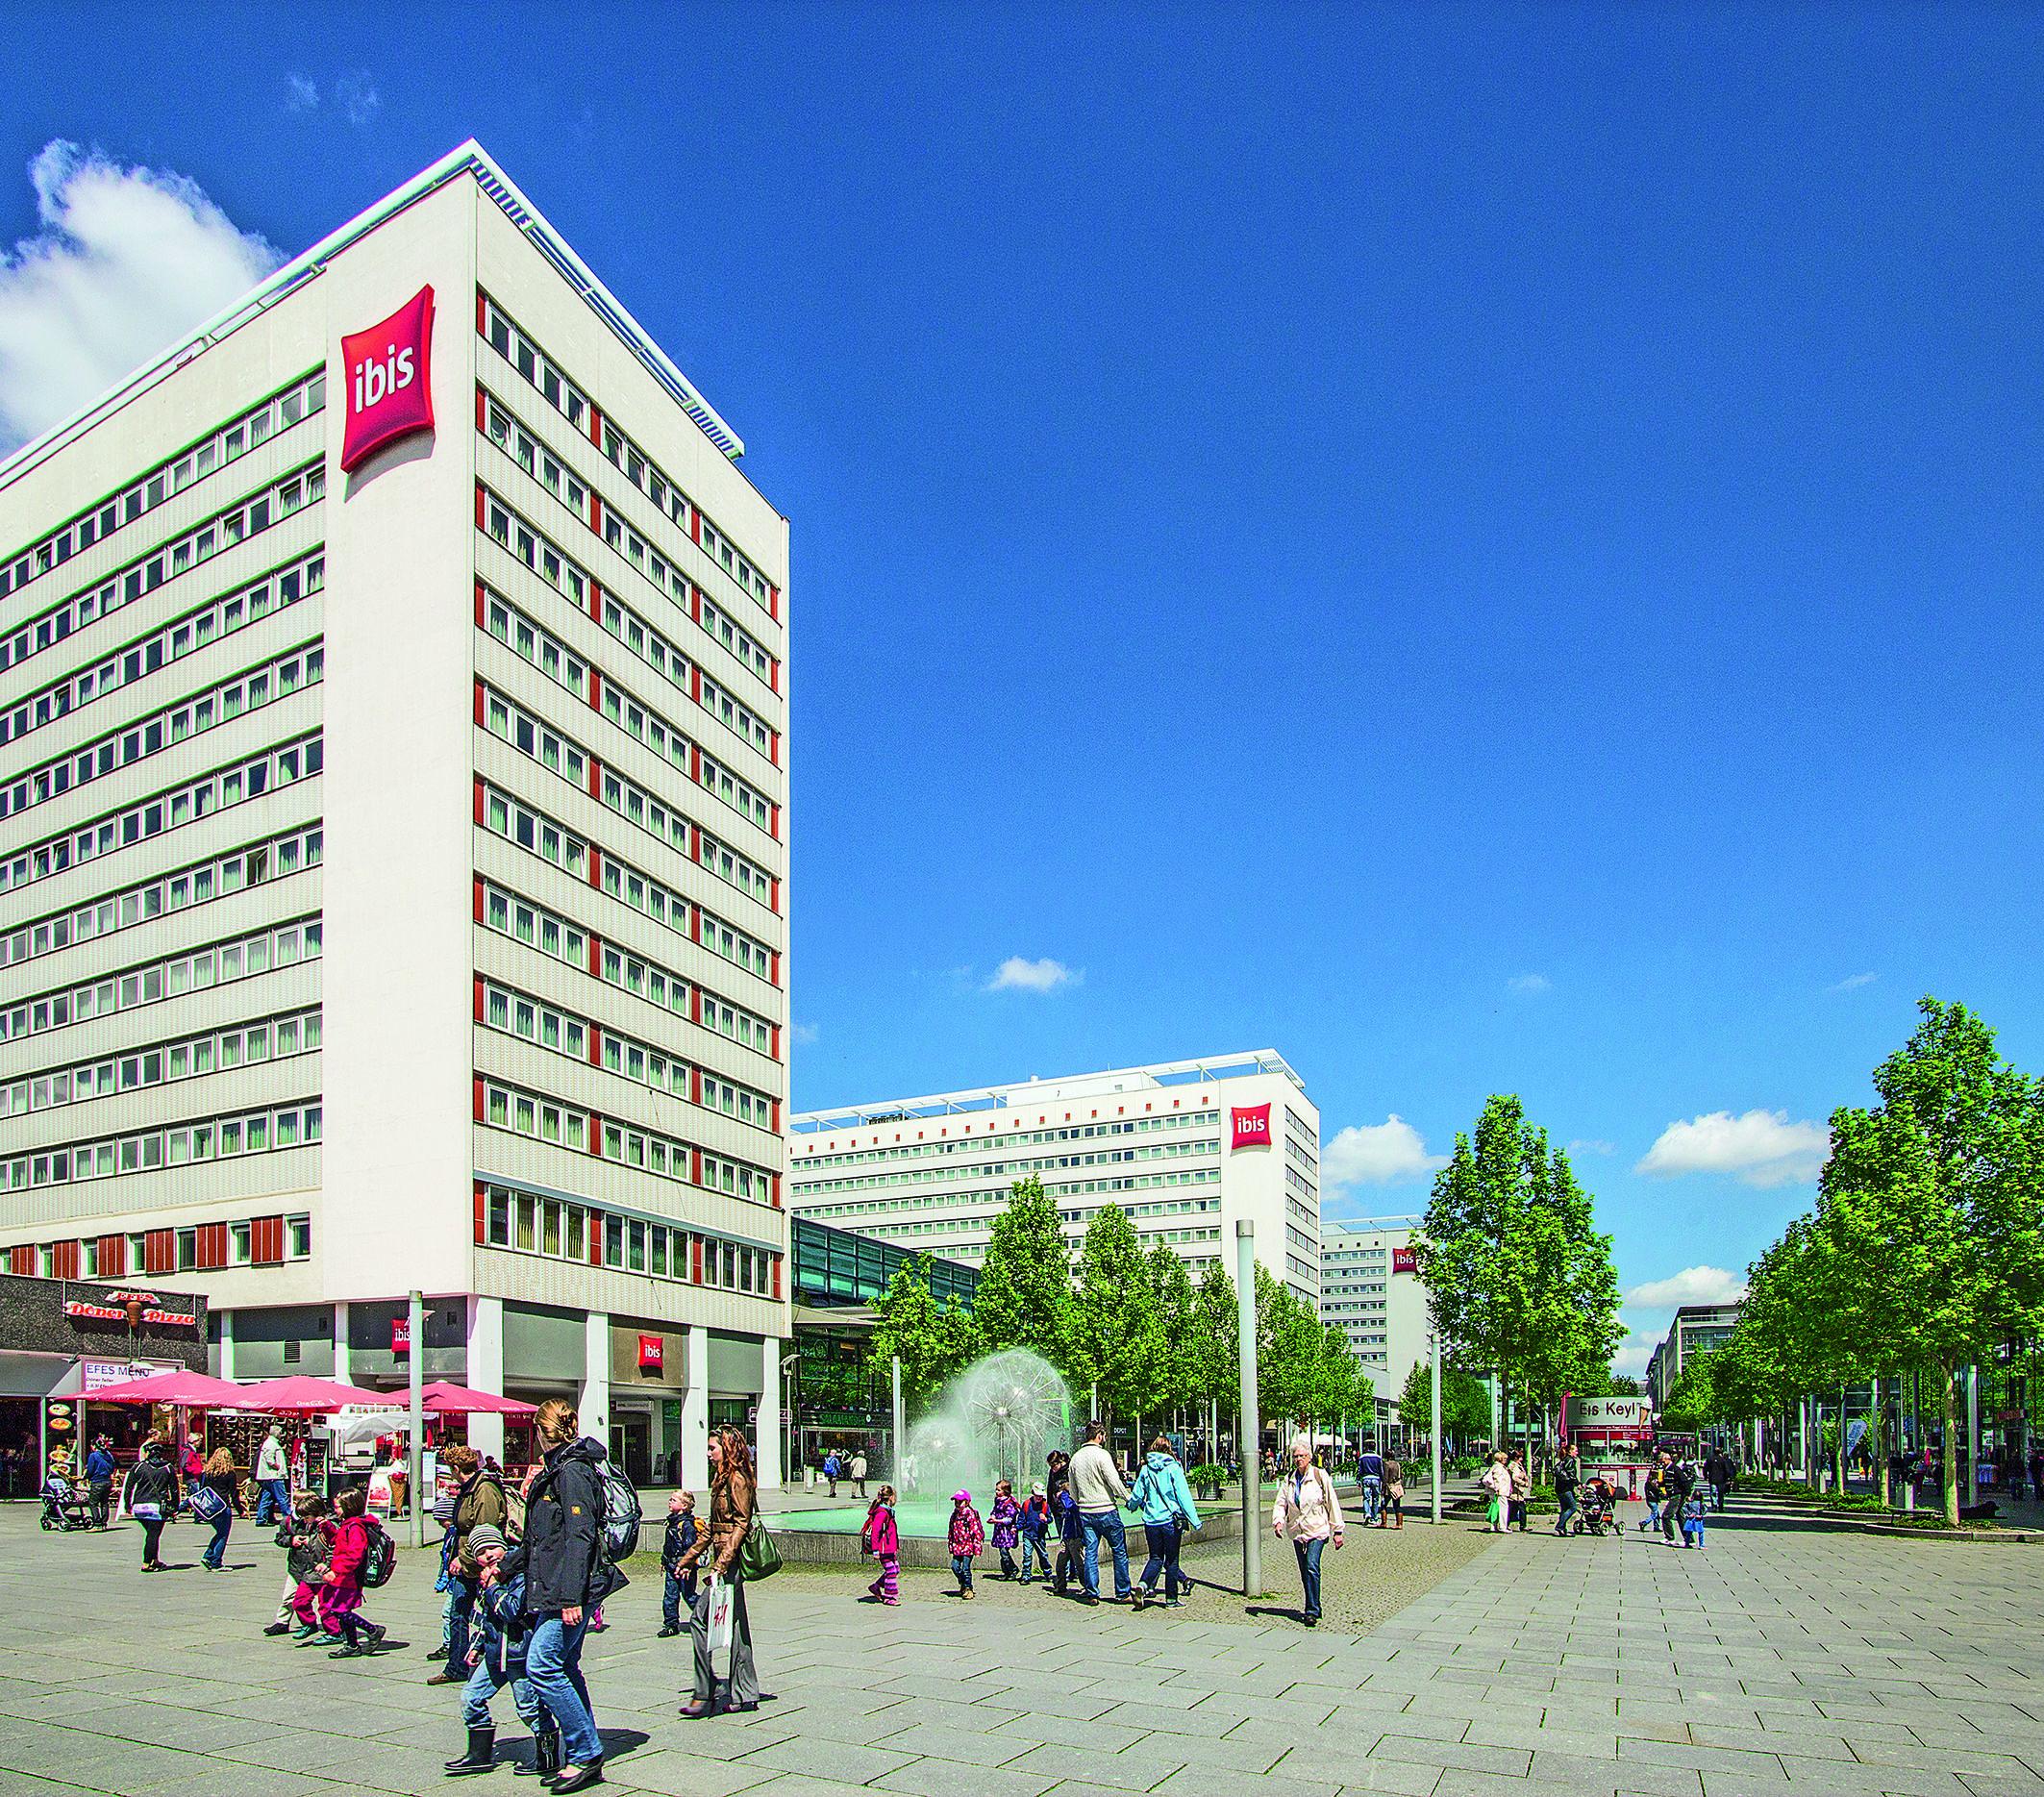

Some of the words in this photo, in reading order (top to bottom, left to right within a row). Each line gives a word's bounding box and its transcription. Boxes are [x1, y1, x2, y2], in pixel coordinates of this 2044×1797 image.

[355, 343, 414, 414] ibis
[1237, 1115, 1265, 1134] ibis
[1396, 1253, 1414, 1264] ibis
[116, 1291, 155, 1302] EFES
[70, 1302, 126, 1318] Döner
[146, 1310, 196, 1325] Pizza
[394, 1328, 411, 1342] ibis
[645, 1344, 661, 1358] ibis
[87, 1363, 115, 1375] EFES
[1580, 1402, 1600, 1416] Eis
[1606, 1401, 1635, 1419] Keyl
